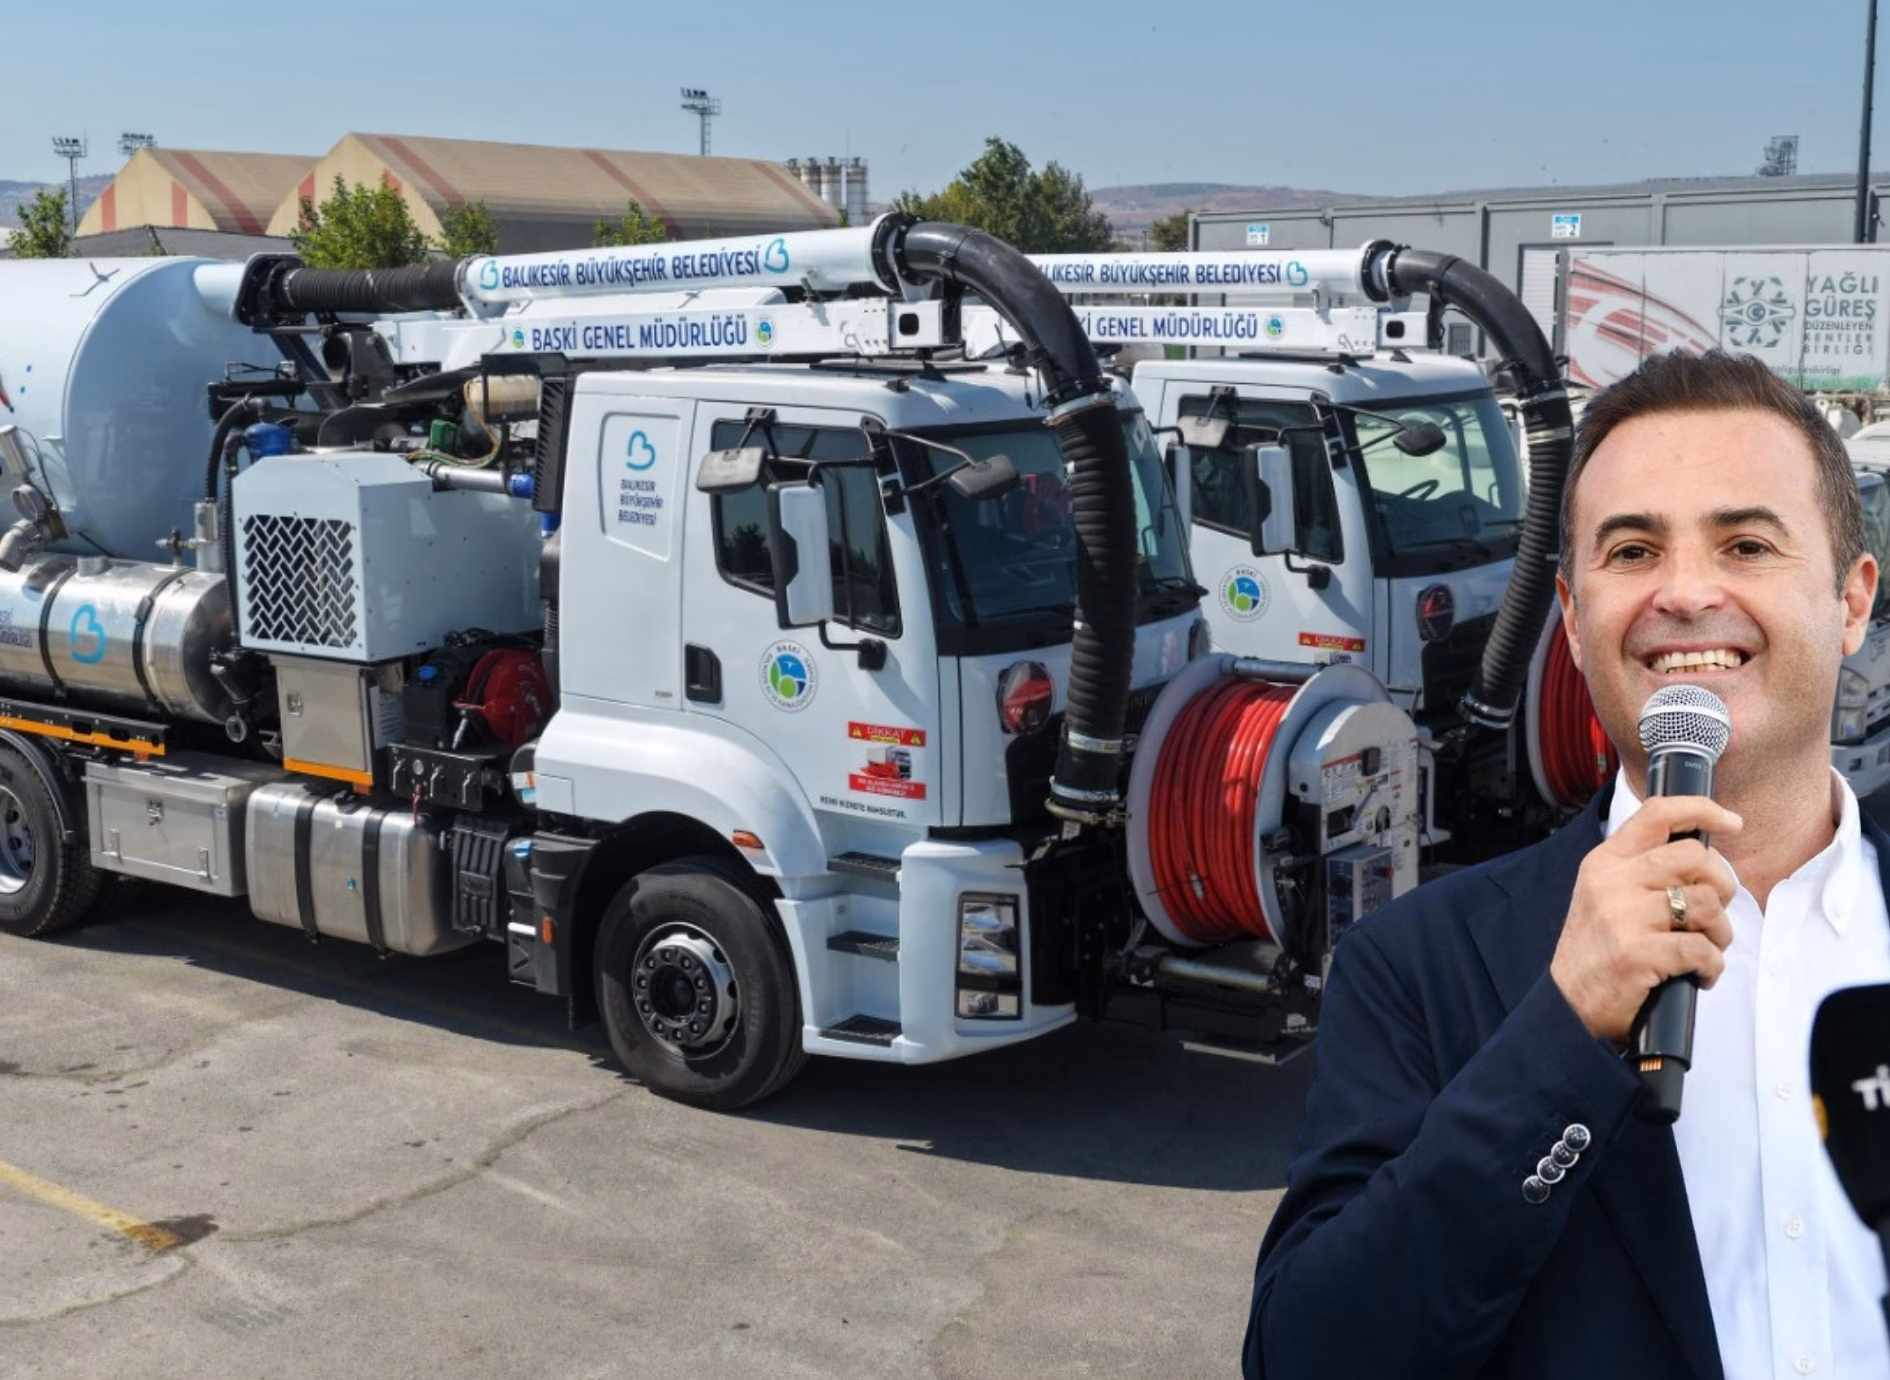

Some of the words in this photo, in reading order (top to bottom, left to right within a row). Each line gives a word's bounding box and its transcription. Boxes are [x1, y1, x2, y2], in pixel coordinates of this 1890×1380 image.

[502, 258, 571, 288] BALIKESİR
[576, 252, 667, 287] BÜYÜKŞEHİR
[672, 245, 761, 279] BELEDİYESİ
[1100, 259, 1190, 287] BÜYÜKŞEHİR
[1195, 259, 1282, 284] BELEDİYESİ
[1807, 271, 1879, 294] YAĞLI
[1805, 295, 1876, 321] GÜREŞ
[532, 321, 578, 351] BASKİ
[583, 324, 635, 350] GENEL
[639, 314, 747, 349] MÜDÜRLÜĞÜ
[1096, 316, 1148, 337] GENEL
[1153, 312, 1258, 339] MÜDÜRLÜĞÜ
[1805, 319, 1873, 331] DÜZENLEYEN
